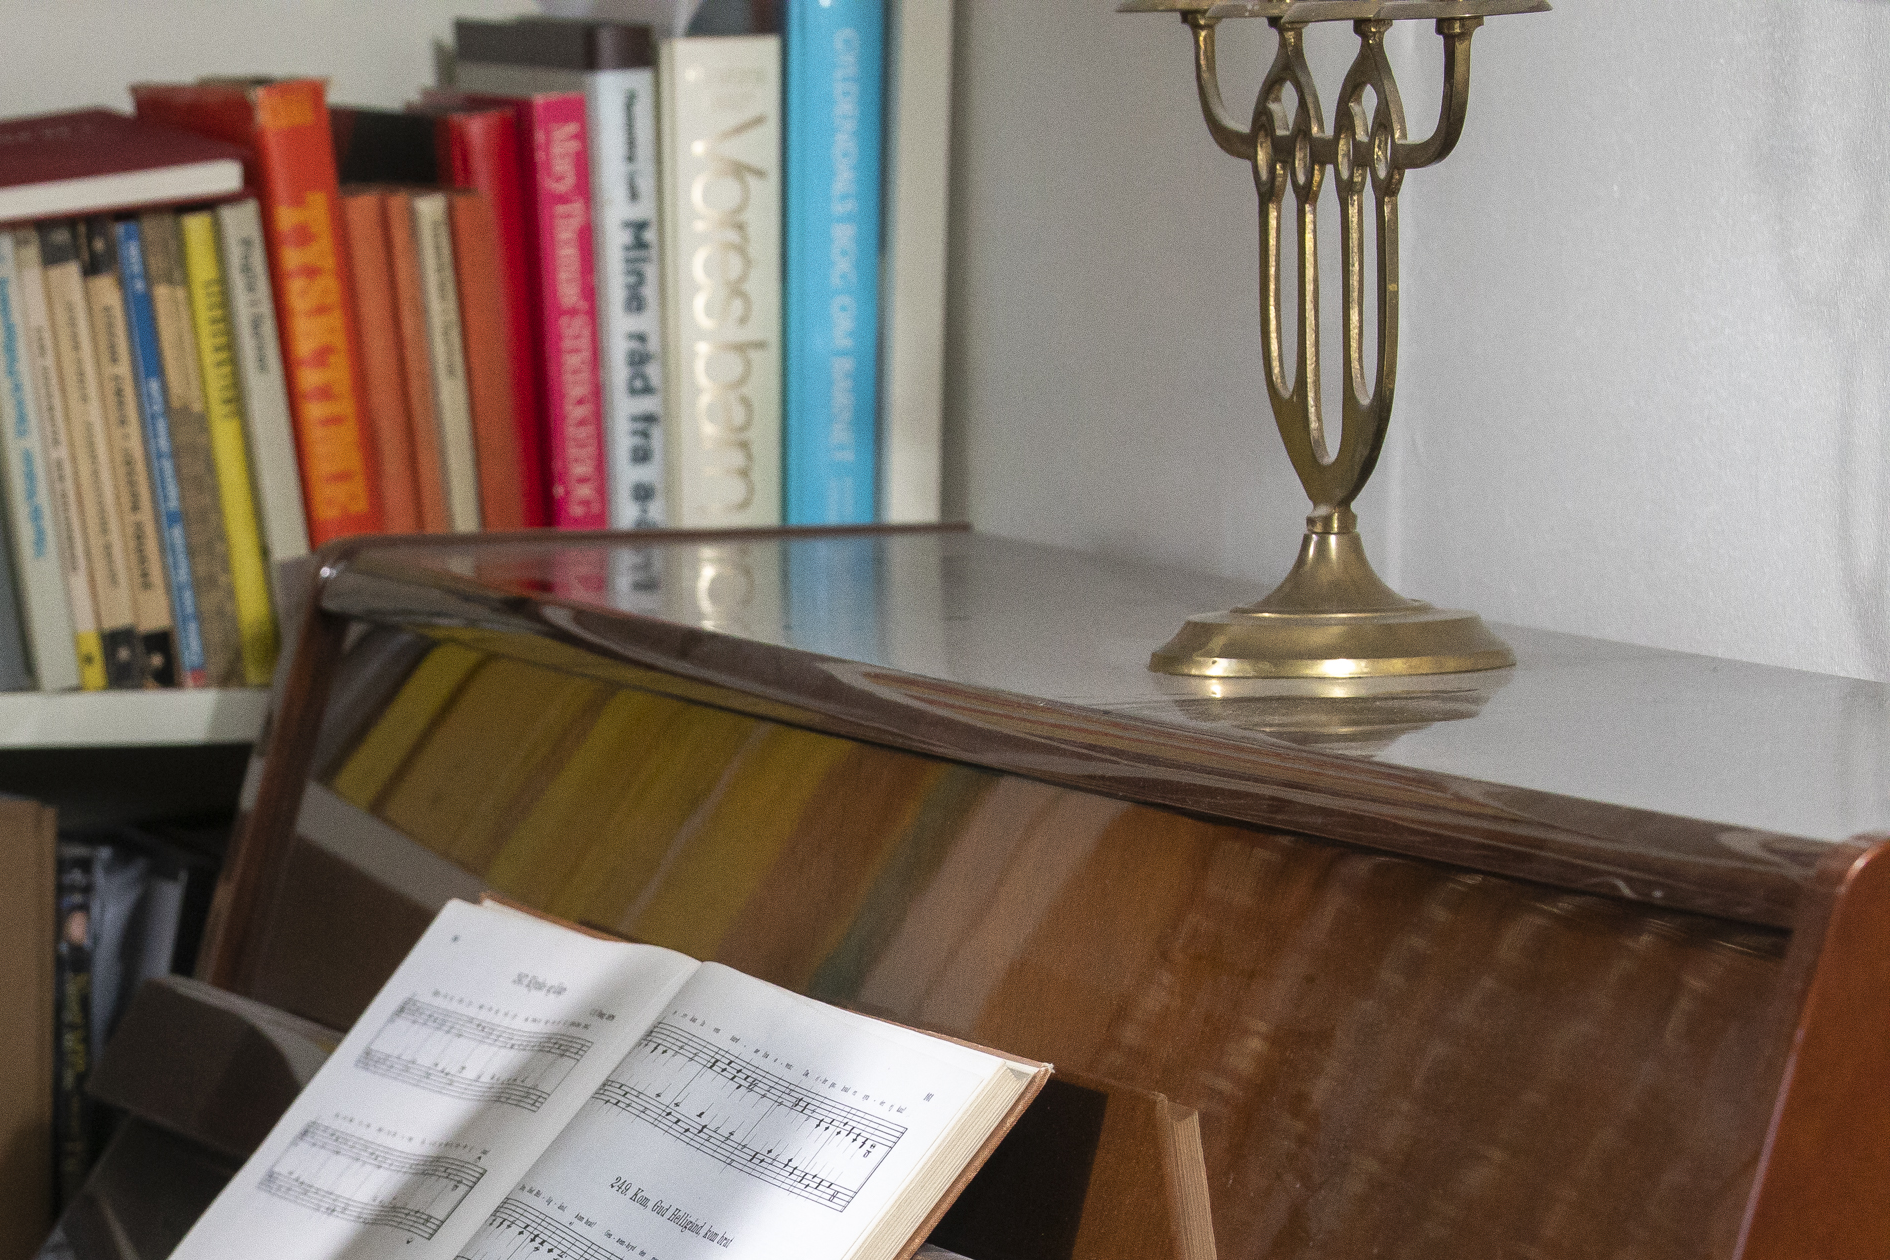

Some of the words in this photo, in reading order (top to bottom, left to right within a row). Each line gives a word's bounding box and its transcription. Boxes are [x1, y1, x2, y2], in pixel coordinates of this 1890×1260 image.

[544, 121, 582, 192] Mary
[830, 27, 859, 213] GYLDENDALS
[691, 114, 769, 329] Vores
[830, 224, 856, 288] BOG
[621, 219, 651, 314] Mine
[625, 330, 657, 396] råd
[831, 295, 856, 348] OM
[559, 315, 602, 517] STRIKKEBOG
[628, 411, 660, 466] fra
[693, 340, 767, 515] barn
[830, 357, 856, 462] BARNET
[609, 1176, 633, 1196] 249.
[629, 1187, 651, 1210] Kom,
[651, 1200, 672, 1218] Gud
[667, 1208, 707, 1237] Helligånd,
[702, 1225, 720, 1243] kom
